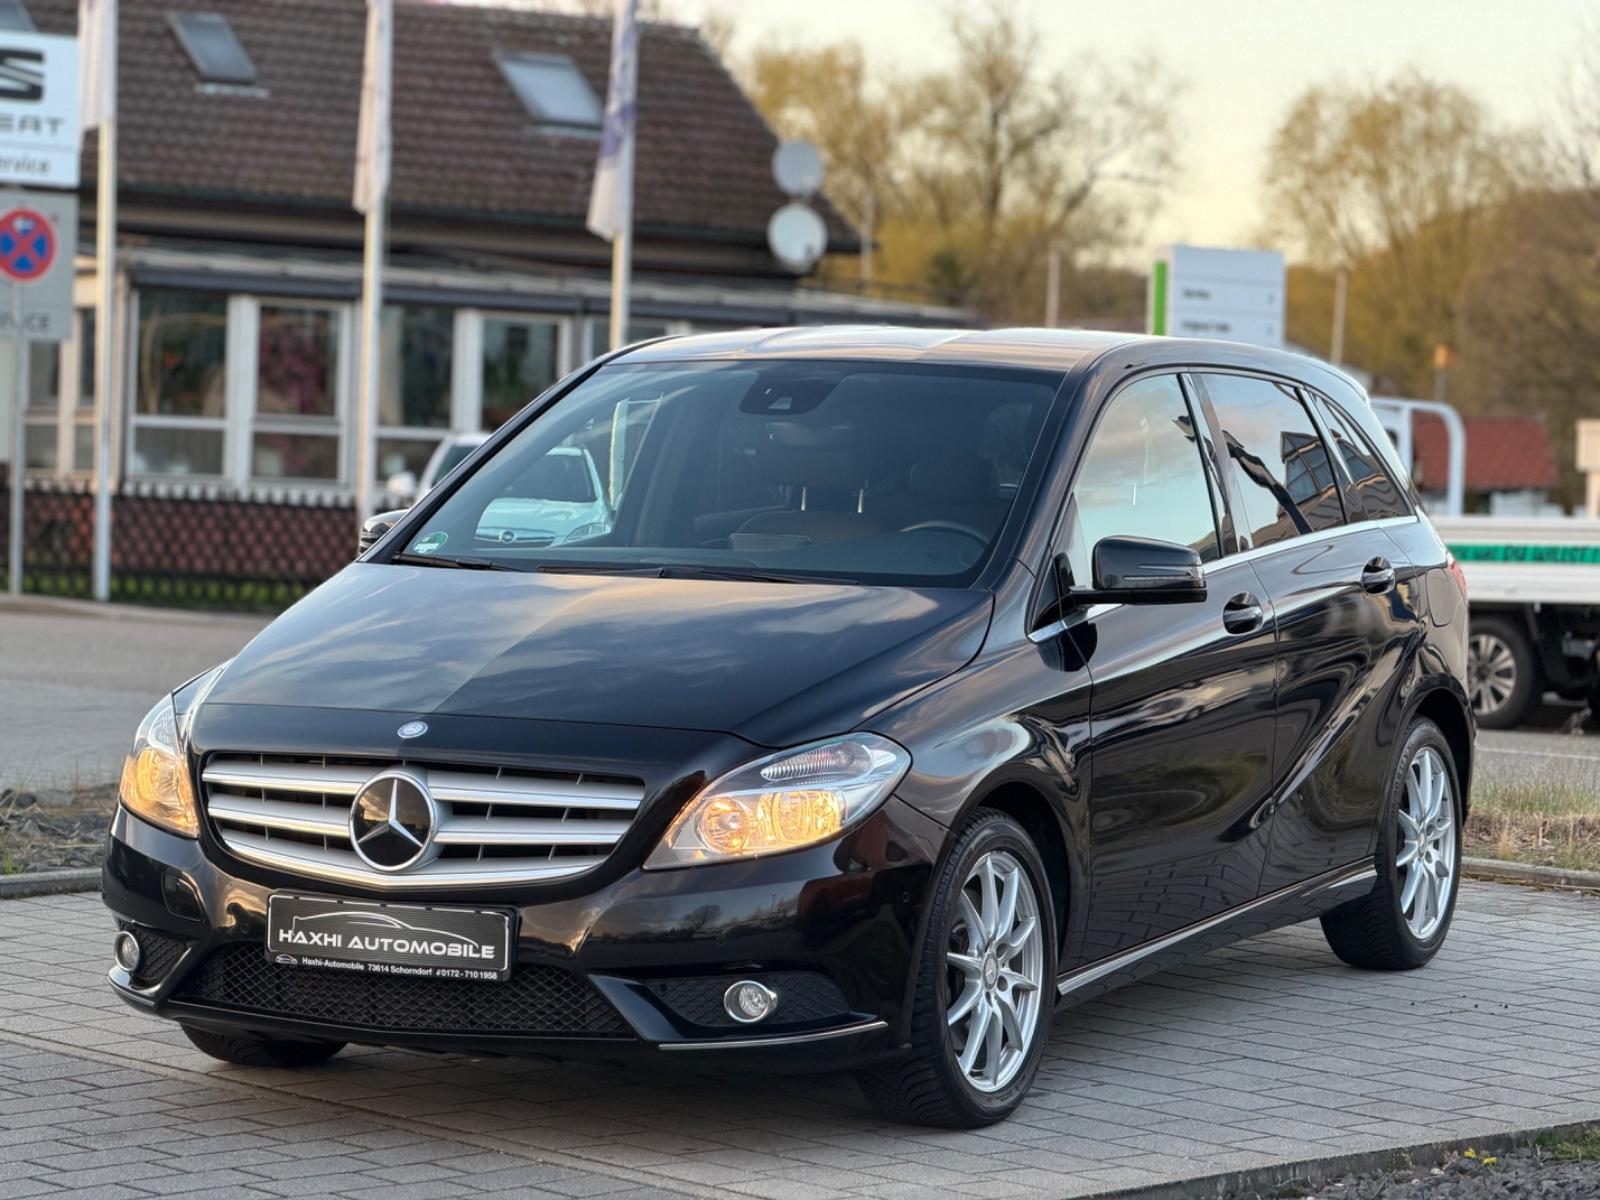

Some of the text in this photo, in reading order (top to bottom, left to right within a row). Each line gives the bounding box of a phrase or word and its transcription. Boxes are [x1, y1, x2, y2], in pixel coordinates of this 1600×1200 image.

[278, 929, 495, 960] HAXHI AUTOMOBILE
[302, 957, 364, 971] Haxhi-Automobile
[368, 963, 389, 973] 73614
[390, 965, 433, 976] Schorndorf
